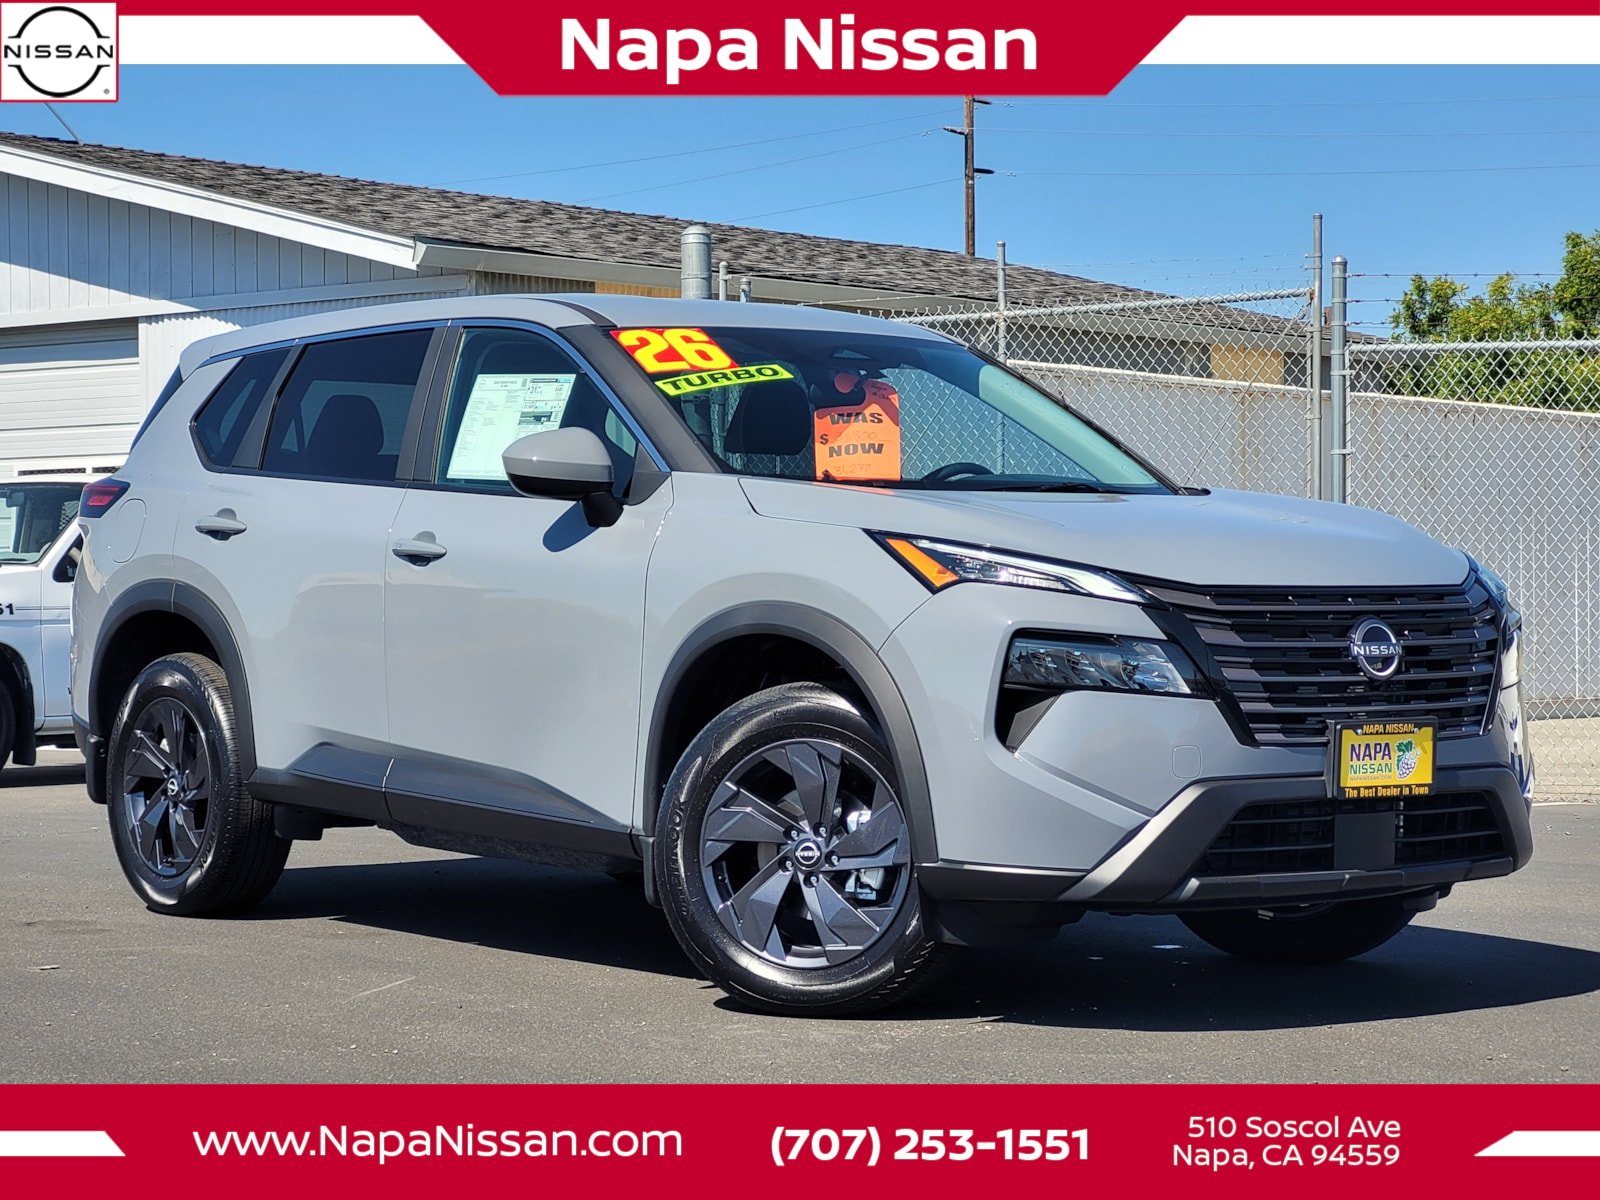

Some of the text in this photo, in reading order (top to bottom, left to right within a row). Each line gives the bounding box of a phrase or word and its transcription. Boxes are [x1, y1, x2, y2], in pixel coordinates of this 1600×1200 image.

[618, 328, 732, 374] 26
[662, 367, 780, 391] TURBO
[829, 412, 883, 425] WAS
[820, 433, 829, 445] $
[828, 443, 884, 458] NOW
[1353, 645, 1402, 655] NISSAN
[1363, 723, 1415, 734] NAPA NISSAN
[1350, 742, 1392, 761] NAPA
[1349, 763, 1392, 774] NISSAN
[1344, 785, 1429, 798] The Best Dealer in Town
